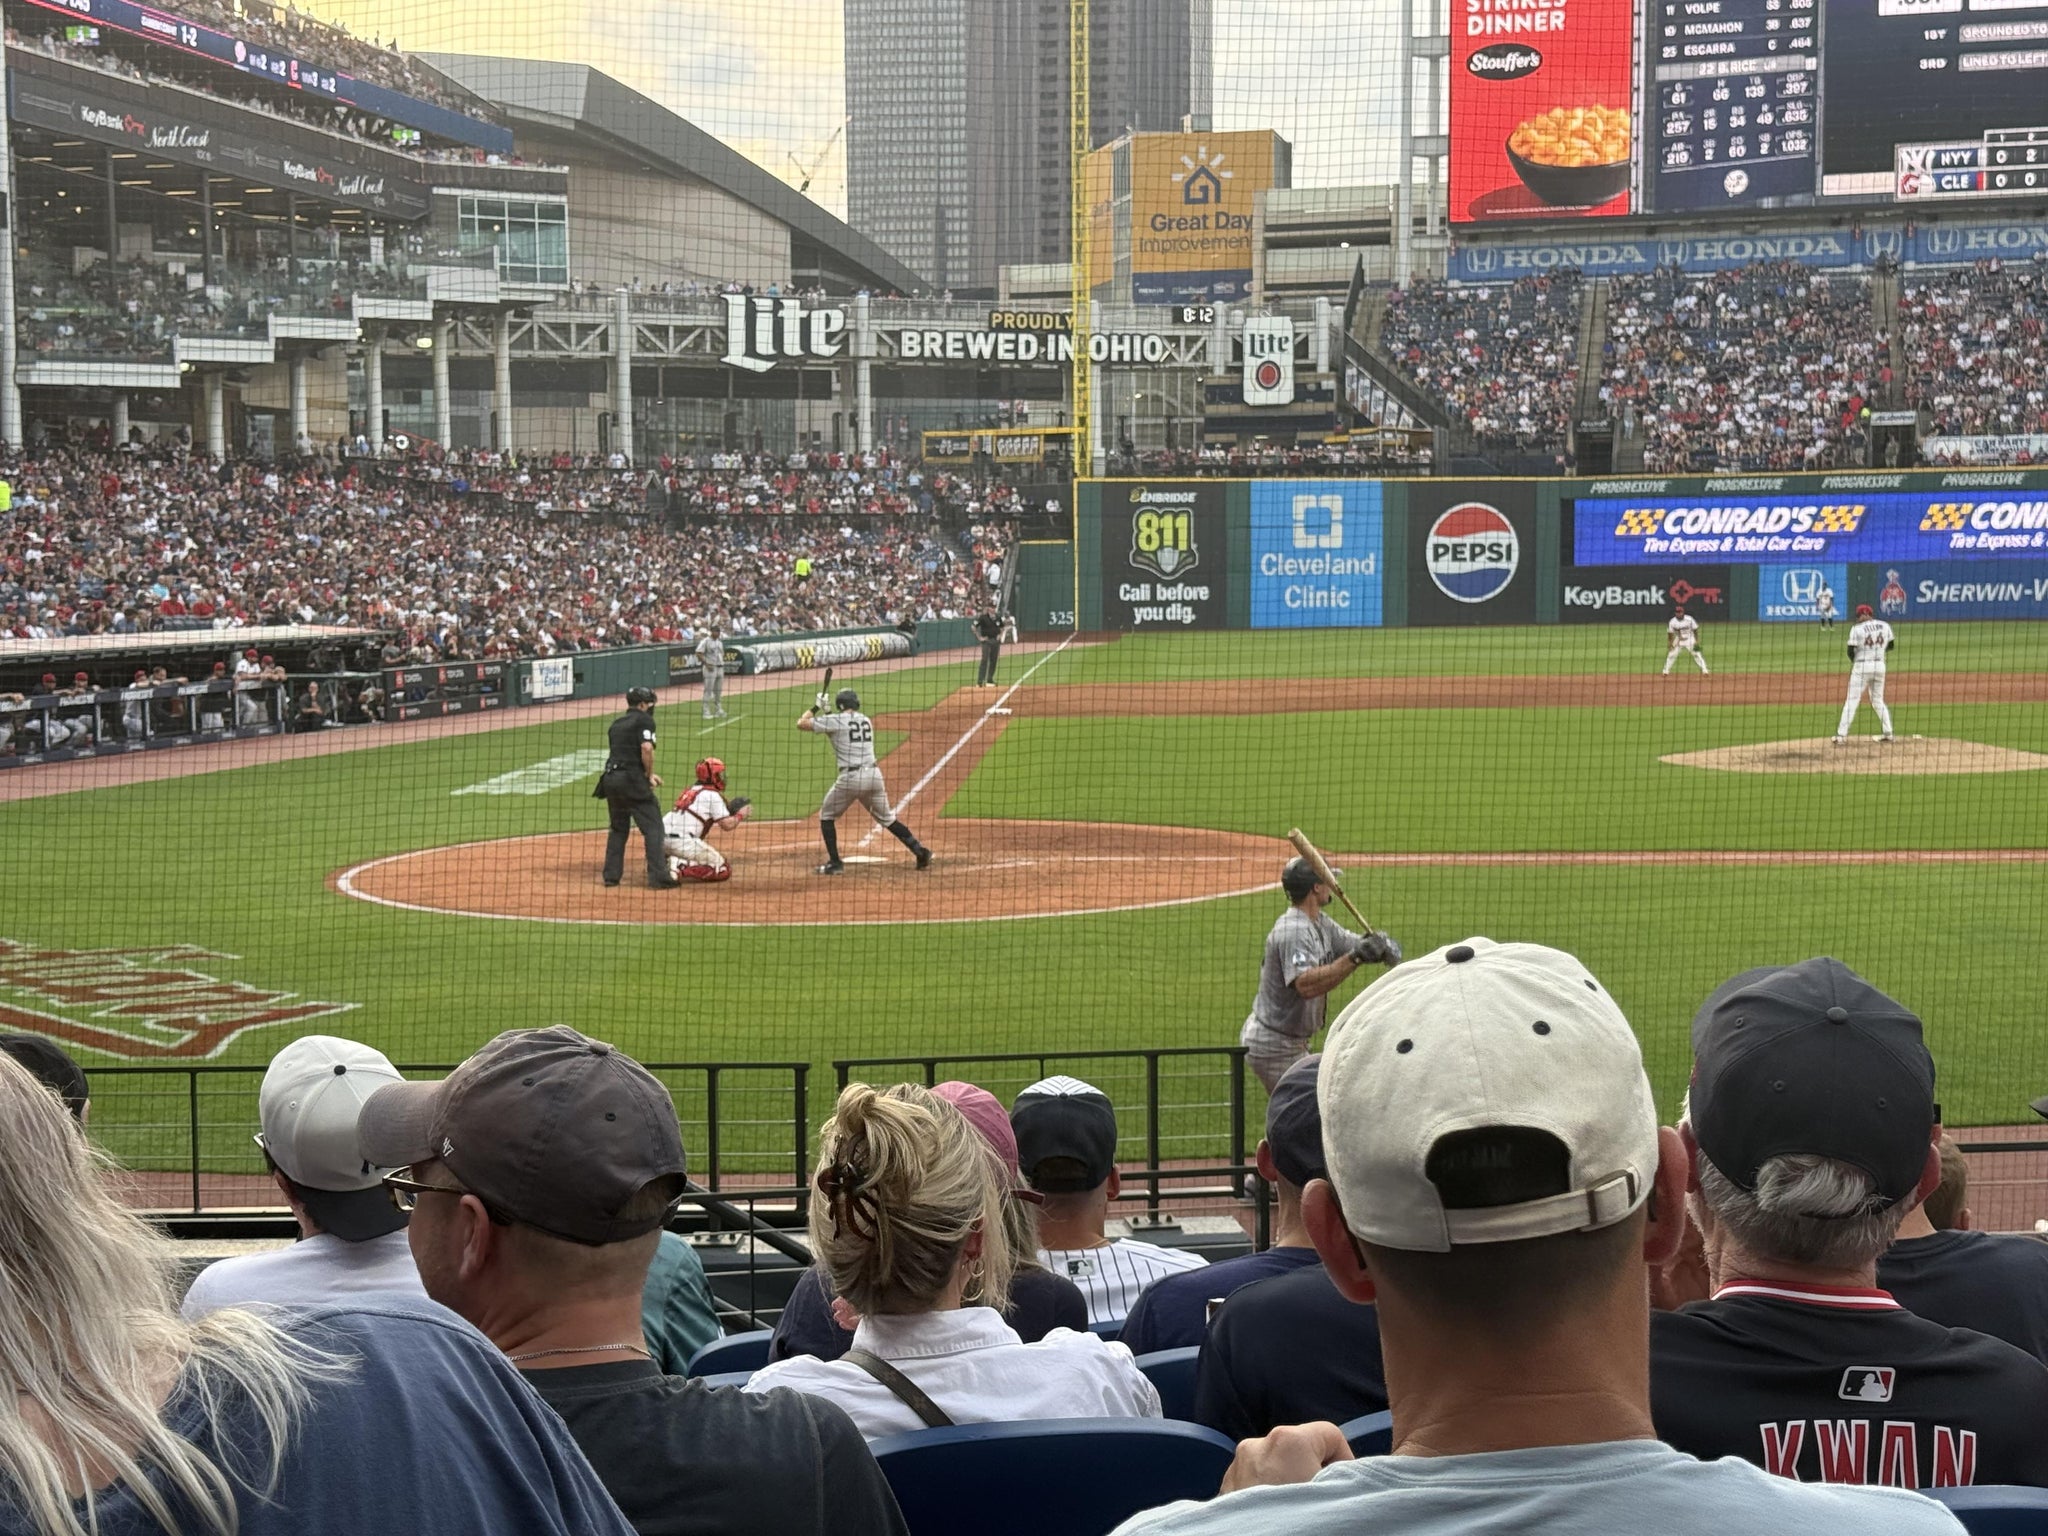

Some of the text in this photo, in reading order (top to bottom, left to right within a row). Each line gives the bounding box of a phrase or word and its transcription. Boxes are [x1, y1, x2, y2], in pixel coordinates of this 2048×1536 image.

[1685, 2, 1721, 15] VOLPE
[1467, 10, 1566, 36] DINNER
[1684, 21, 1744, 36] MCMAHON
[1923, 29, 1948, 41] 1ST
[1962, 23, 2031, 39] GROUNDED
[180, 25, 198, 48] 1-2
[1684, 42, 1736, 56] ESCARRA
[1469, 51, 1541, 72] Stouffer's
[1699, 62, 1717, 75] 22
[1730, 59, 1757, 73] RICE
[1919, 51, 2048, 70] 3RD LINED TO LEFT
[1744, 85, 1767, 98] 139
[81, 105, 124, 132] KeyBank
[1666, 121, 1691, 135] 257
[1729, 115, 1747, 128] 34
[1756, 112, 1774, 125] 49
[144, 125, 210, 149] North Coast
[1667, 151, 1690, 165] 219
[1940, 148, 2038, 166] NYY 0 2
[283, 160, 317, 182] KeyBank
[1941, 172, 2037, 190] CLE 0 0
[1151, 211, 1253, 233] Great Day
[1502, 244, 1647, 268] HONDA
[1693, 235, 1846, 261] HONDA
[990, 312, 1075, 331] PROUDLY
[719, 293, 845, 374] Lite
[900, 330, 1164, 363] BREWED IN OHIO
[1247, 333, 1290, 359] Lite
[1590, 480, 1669, 495] PROGRESSIVE
[1704, 477, 1784, 492] PROGRESSIVE
[1821, 475, 1902, 489] PROGRESSIVE
[1942, 472, 2025, 487] PROGRESSIVE
[1139, 491, 1198, 504] ENBRIDGE
[1663, 506, 1819, 535] CONRAD'S
[1137, 512, 1189, 552] 811
[1976, 531, 2031, 551] Express
[2030, 531, 2045, 548] &
[1432, 542, 1512, 563] PEPSI
[1644, 535, 1826, 555] Tire Express & Total Car Care
[1260, 552, 1376, 577] Cleveland
[1119, 582, 1210, 602] Call before
[1284, 584, 1351, 609] Clinic
[1564, 585, 1666, 610] KeyBank
[1048, 610, 1075, 626] 325
[1133, 603, 1197, 625] you dig.
[1864, 631, 1885, 650] 44
[848, 720, 872, 743] 22
[1759, 1419, 1977, 1488] KWAN
